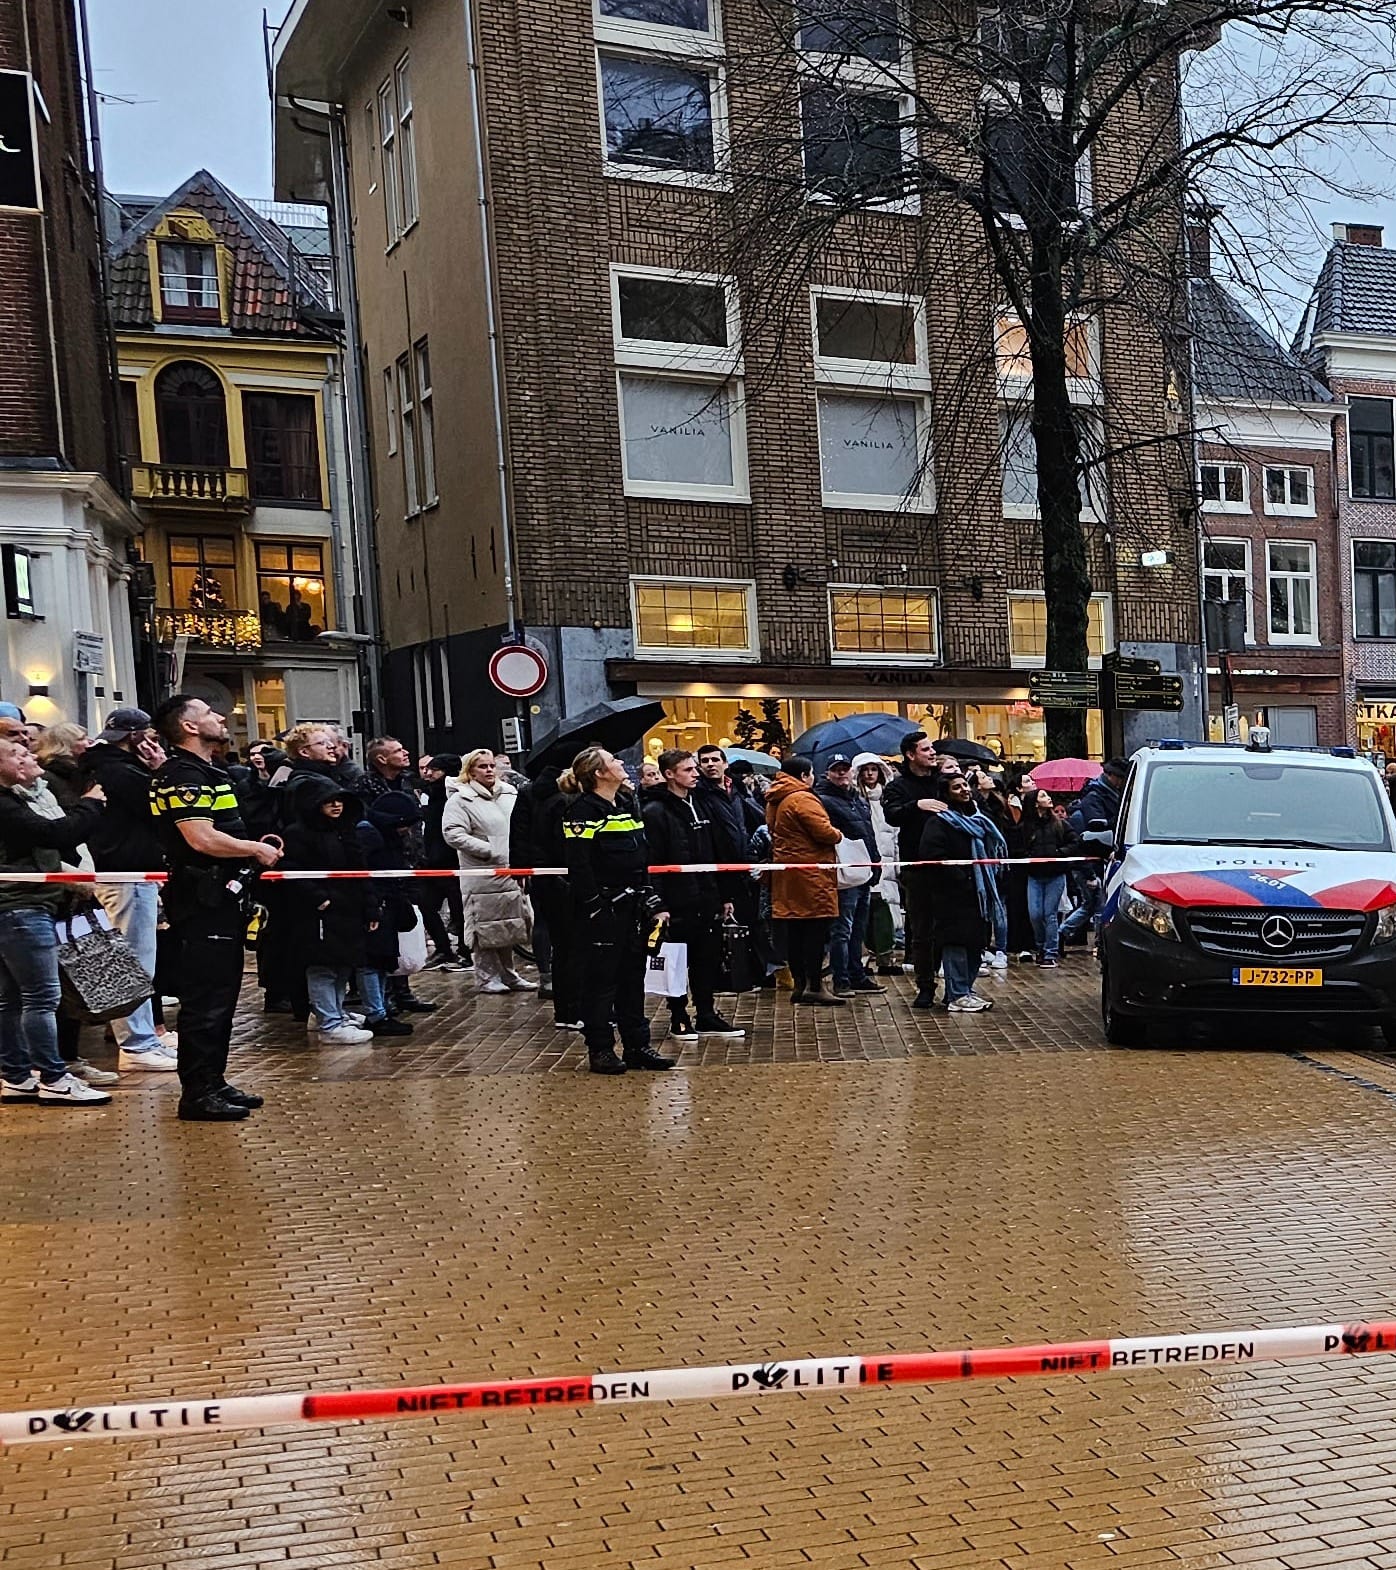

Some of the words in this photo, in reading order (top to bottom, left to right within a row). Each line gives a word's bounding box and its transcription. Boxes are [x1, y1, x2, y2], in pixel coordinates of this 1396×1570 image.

[650, 424, 705, 437] VANILIA
[843, 438, 894, 450] VANILIA
[864, 671, 937, 684] VANILIA
[1215, 859, 1317, 868] POLITIE
[1247, 970, 1314, 984] J-732-PP
[1112, 1342, 1254, 1367] BETREDEN
[398, 1391, 470, 1413] NIET
[480, 1381, 650, 1408] BETREDEN
